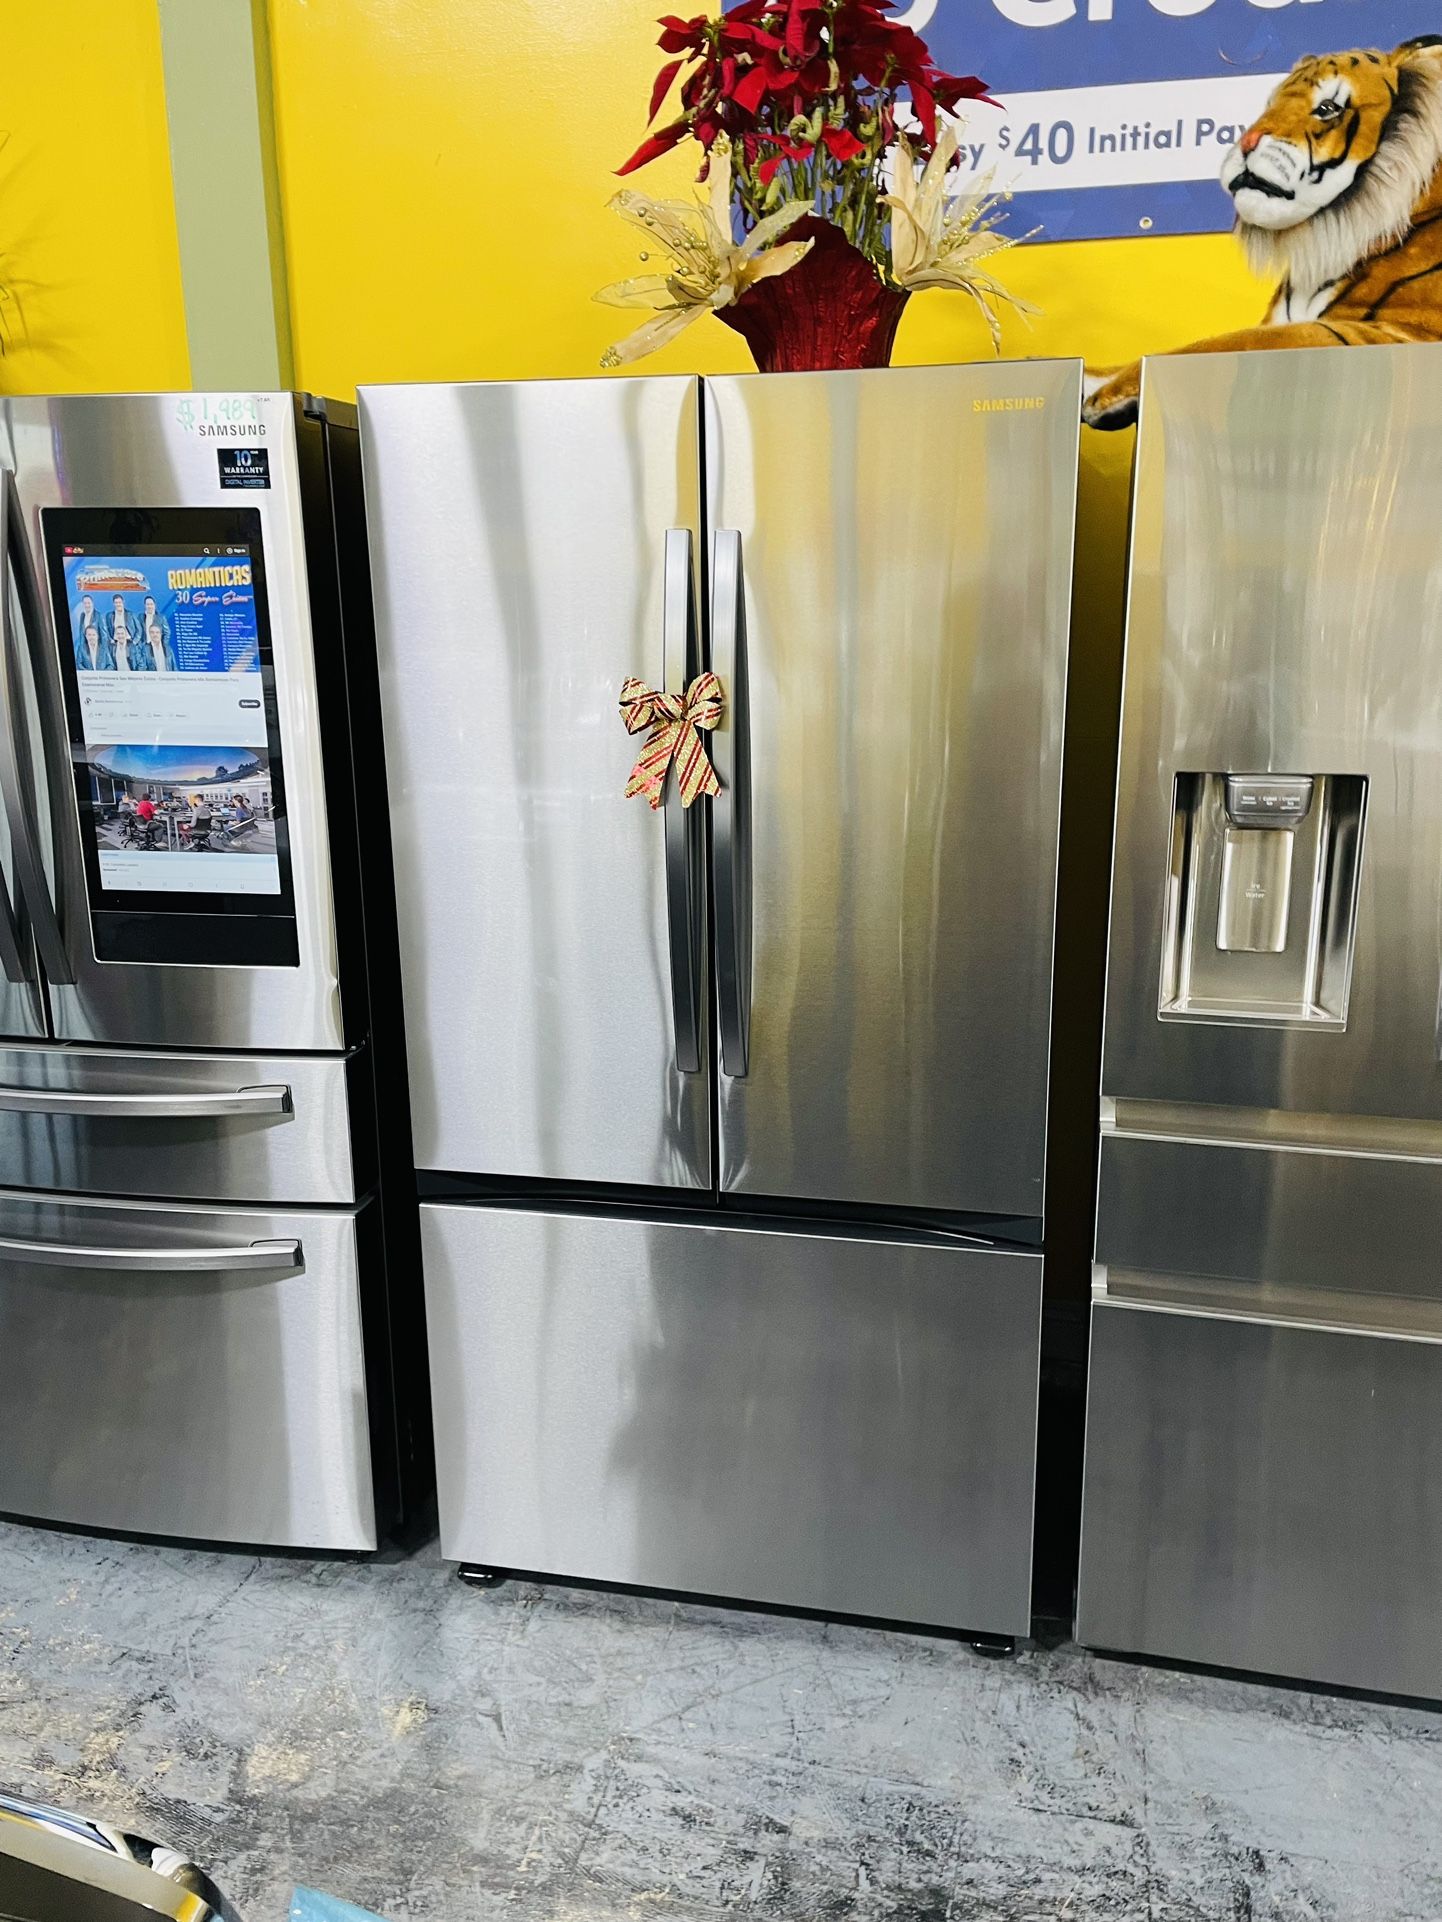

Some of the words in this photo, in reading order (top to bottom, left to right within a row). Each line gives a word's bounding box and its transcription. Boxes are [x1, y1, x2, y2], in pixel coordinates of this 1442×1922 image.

[998, 120, 1075, 166] $40
[1088, 119, 1183, 154] Initial
[973, 396, 1045, 412] SAMSUNG
[199, 424, 266, 436] SAMSUNG
[234, 450, 251, 466] 10
[168, 565, 251, 590] ROMANTICAS
[175, 590, 190, 604] 30
